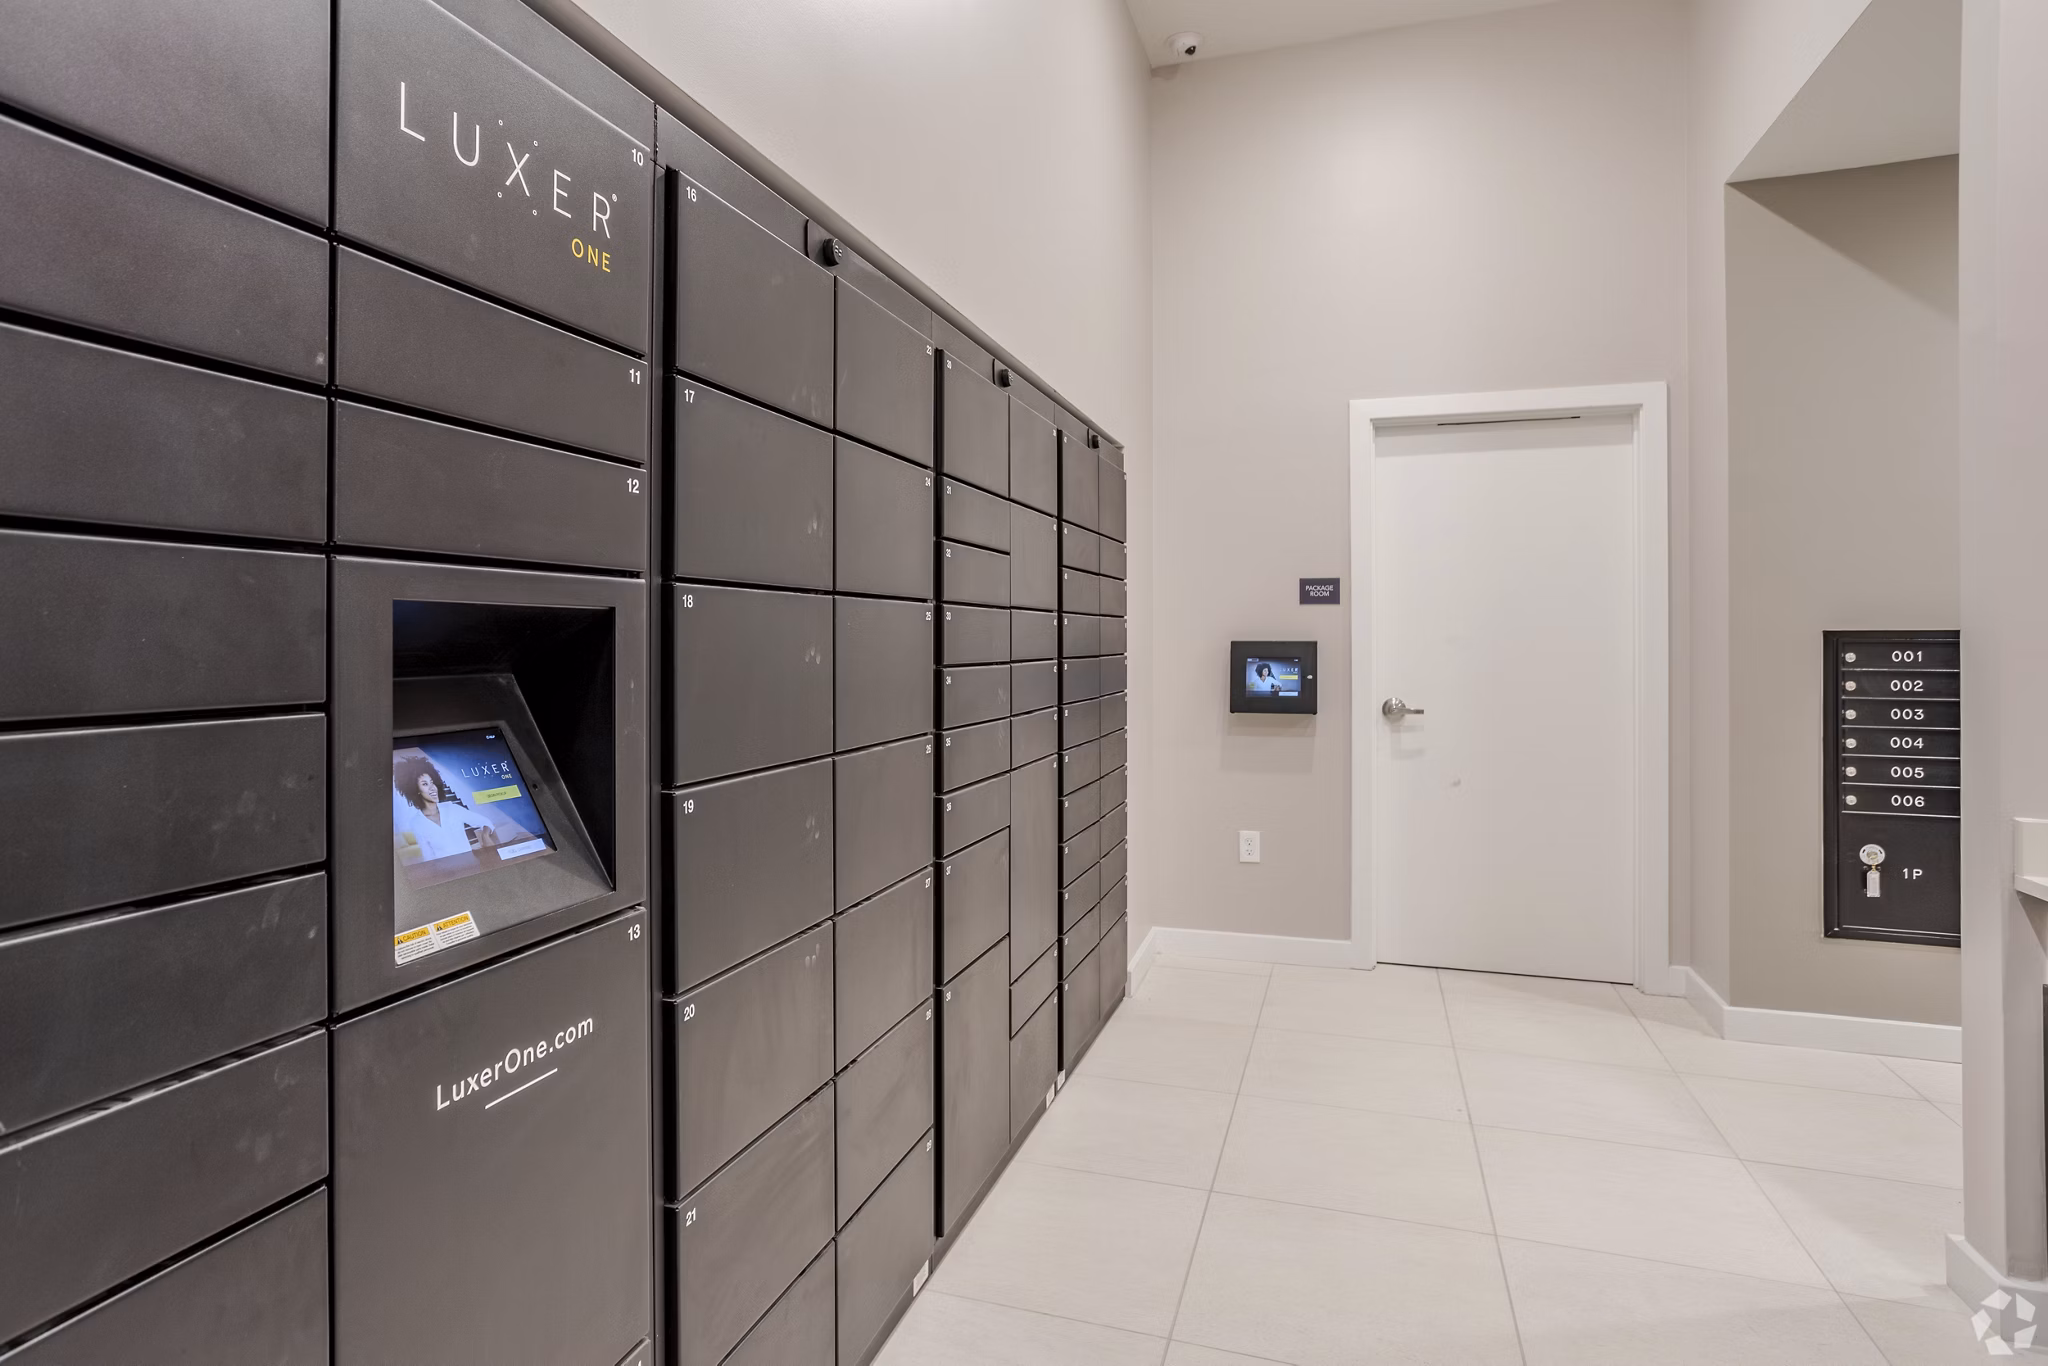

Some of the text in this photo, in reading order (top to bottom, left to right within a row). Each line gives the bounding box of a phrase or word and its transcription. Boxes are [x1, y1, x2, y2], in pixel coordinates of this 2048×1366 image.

[631, 148, 644, 167] 10
[685, 185, 697, 203] 16
[571, 238, 611, 273] ONE
[629, 368, 641, 385] 11
[684, 388, 695, 404] 17
[626, 477, 640, 494] 12
[682, 594, 694, 608] 18
[1891, 650, 1922, 663] 001
[1890, 679, 1924, 692] 002
[1890, 708, 1925, 721] 003
[1889, 736, 1925, 749] 004
[1890, 765, 1925, 779] 005
[682, 799, 695, 815] 19
[1890, 794, 1925, 808] 006
[1902, 867, 1923, 880] 1P
[442, 915, 469, 928] ATTENTION
[402, 930, 427, 941] CAUTION
[627, 923, 641, 941] 13
[683, 1003, 696, 1022] 20
[436, 1017, 593, 1111] LuxerOne.com
[685, 1207, 697, 1227] 21
